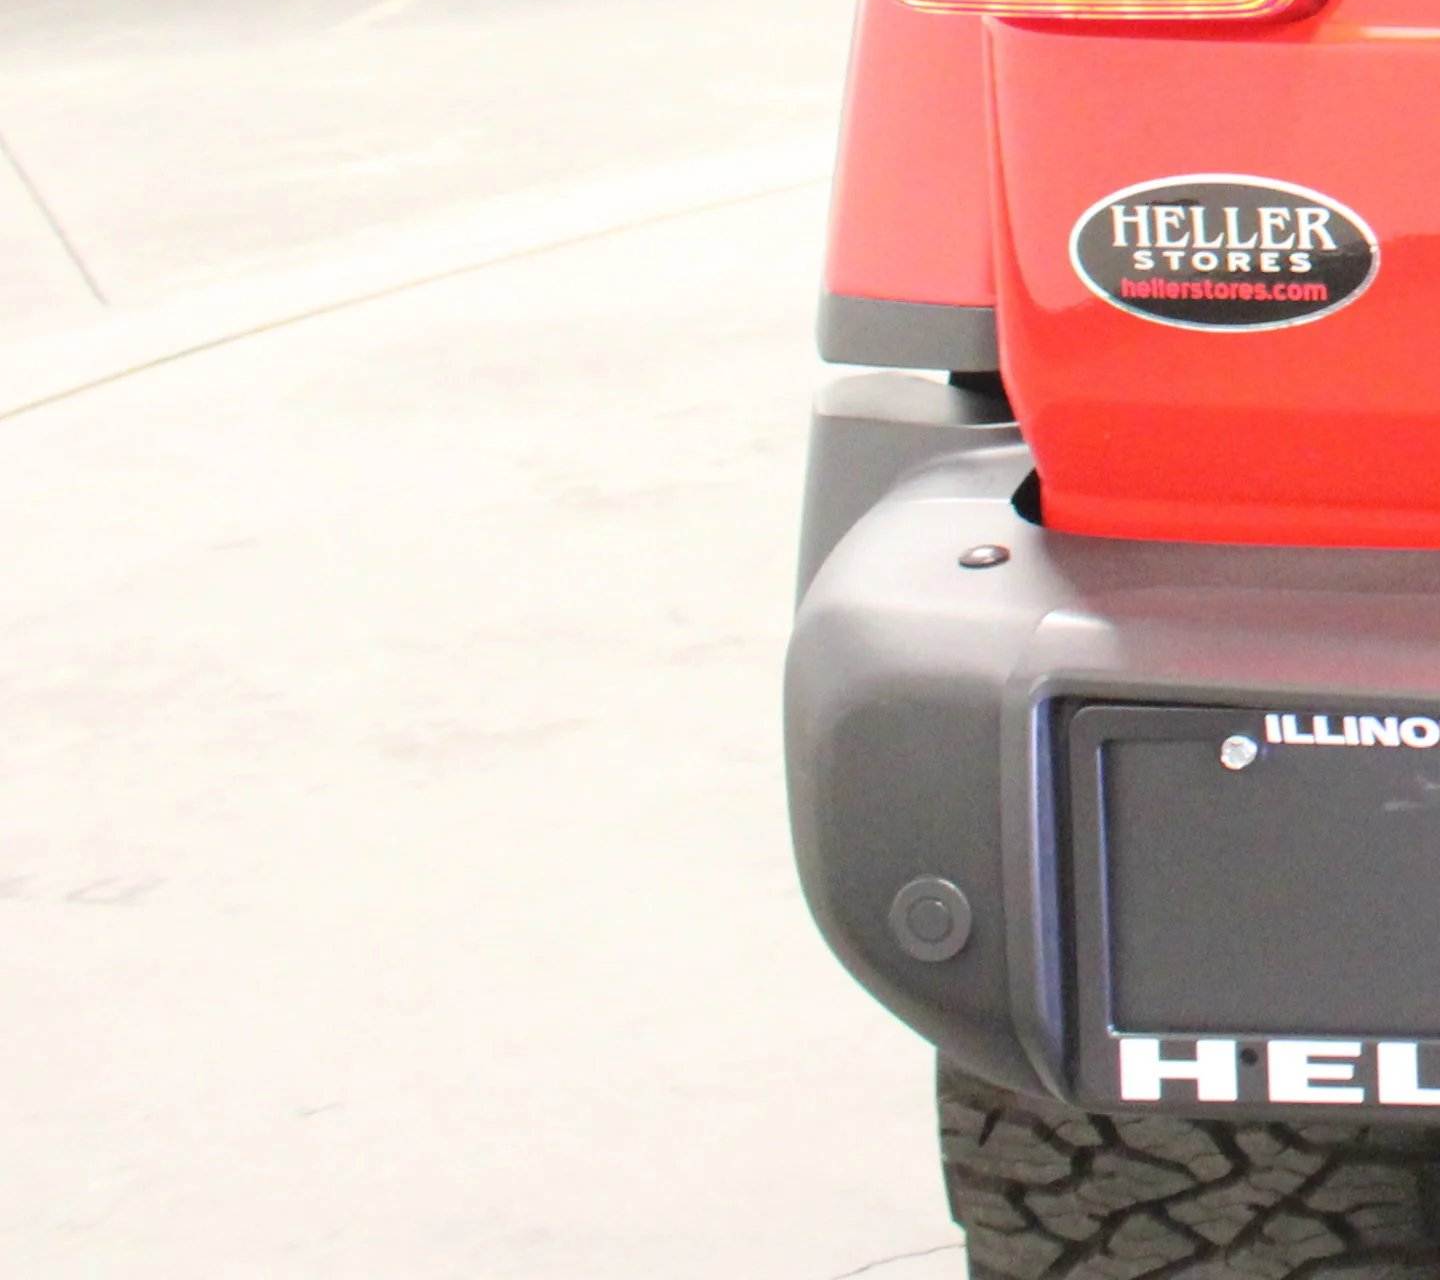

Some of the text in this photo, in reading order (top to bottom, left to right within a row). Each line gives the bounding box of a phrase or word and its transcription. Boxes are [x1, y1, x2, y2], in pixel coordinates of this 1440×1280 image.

[1111, 204, 1337, 251] HELLER
[1134, 250, 1313, 273] STORES
[1120, 277, 1328, 302] hellerstores.com
